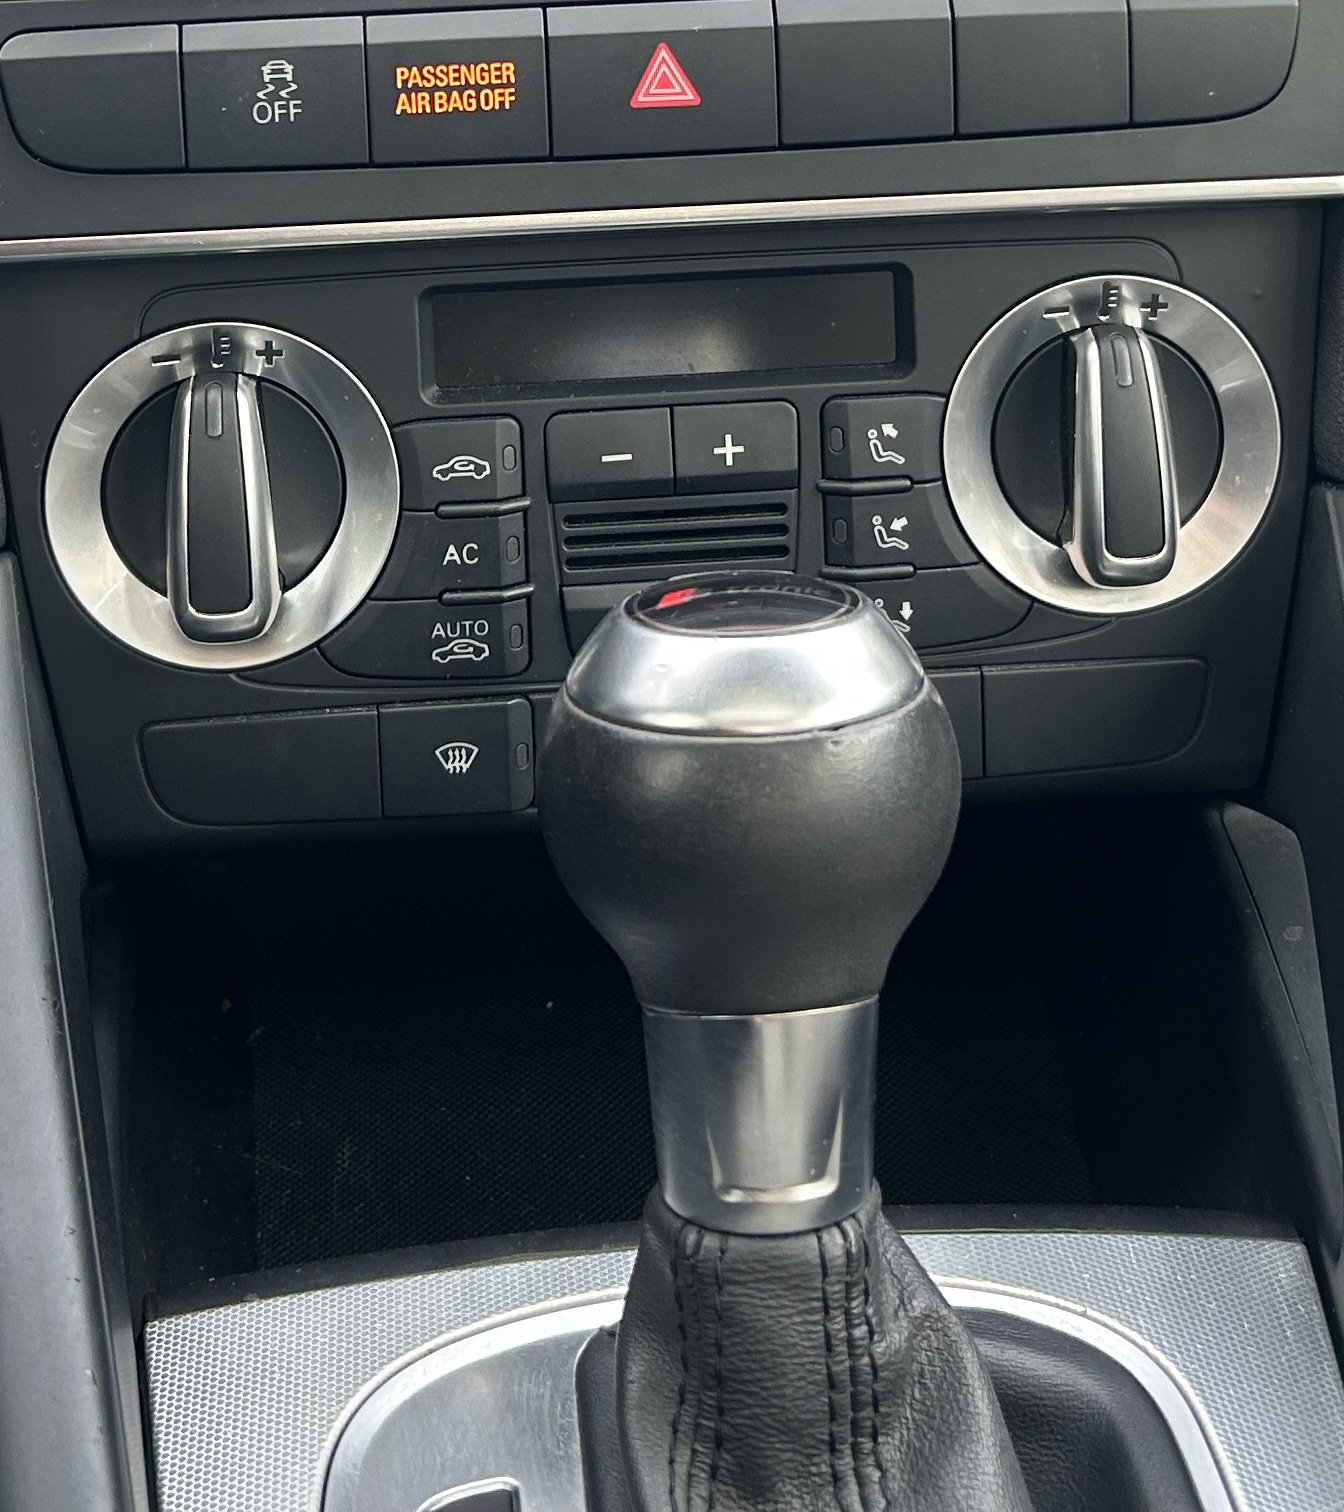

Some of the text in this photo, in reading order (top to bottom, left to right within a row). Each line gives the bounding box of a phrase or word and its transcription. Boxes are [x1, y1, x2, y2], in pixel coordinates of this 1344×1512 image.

[396, 61, 516, 89] PASSENGER
[252, 100, 303, 125] OFF
[395, 87, 516, 115] AIR BAG OFF
[442, 544, 479, 566] AC
[432, 618, 490, 639] AUTO
